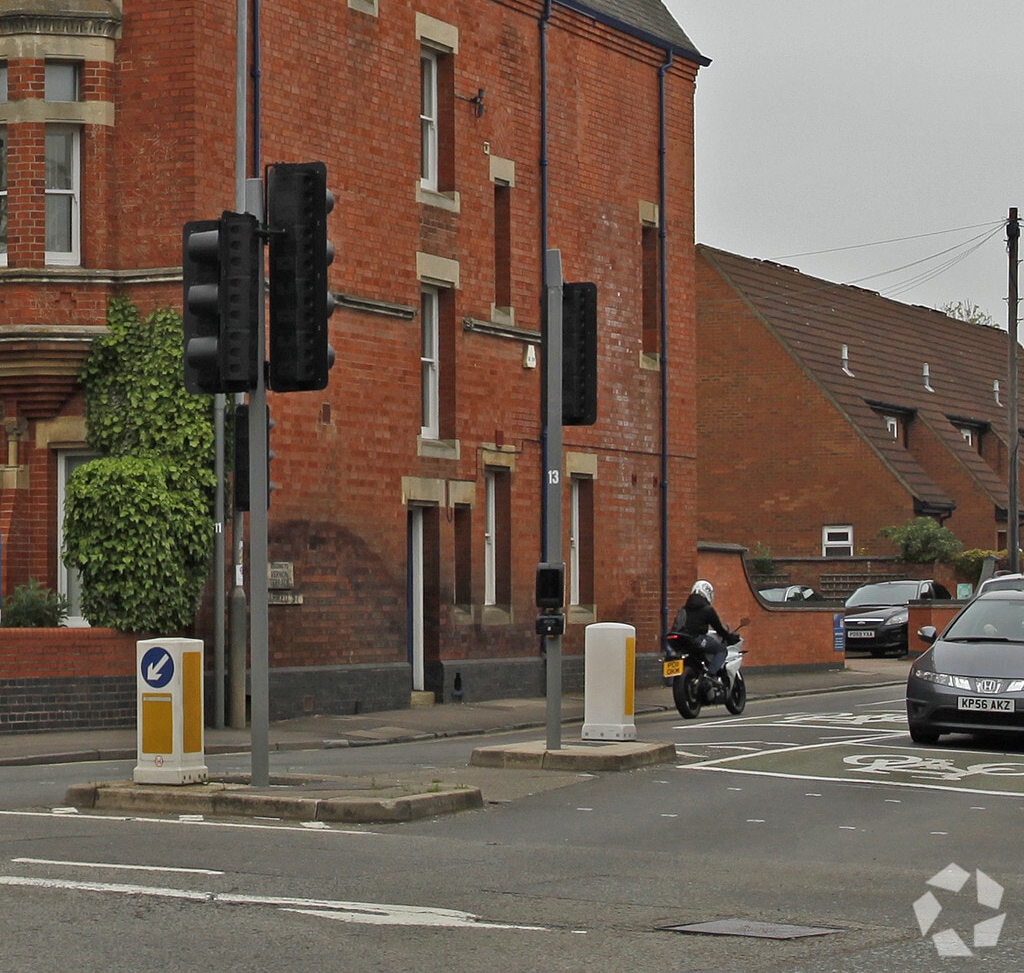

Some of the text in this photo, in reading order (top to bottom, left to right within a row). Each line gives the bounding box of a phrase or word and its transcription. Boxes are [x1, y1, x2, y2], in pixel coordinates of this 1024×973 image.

[548, 469, 559, 484] 13
[215, 522, 222, 533] 11
[961, 698, 1011, 711] KP56 AKZ
